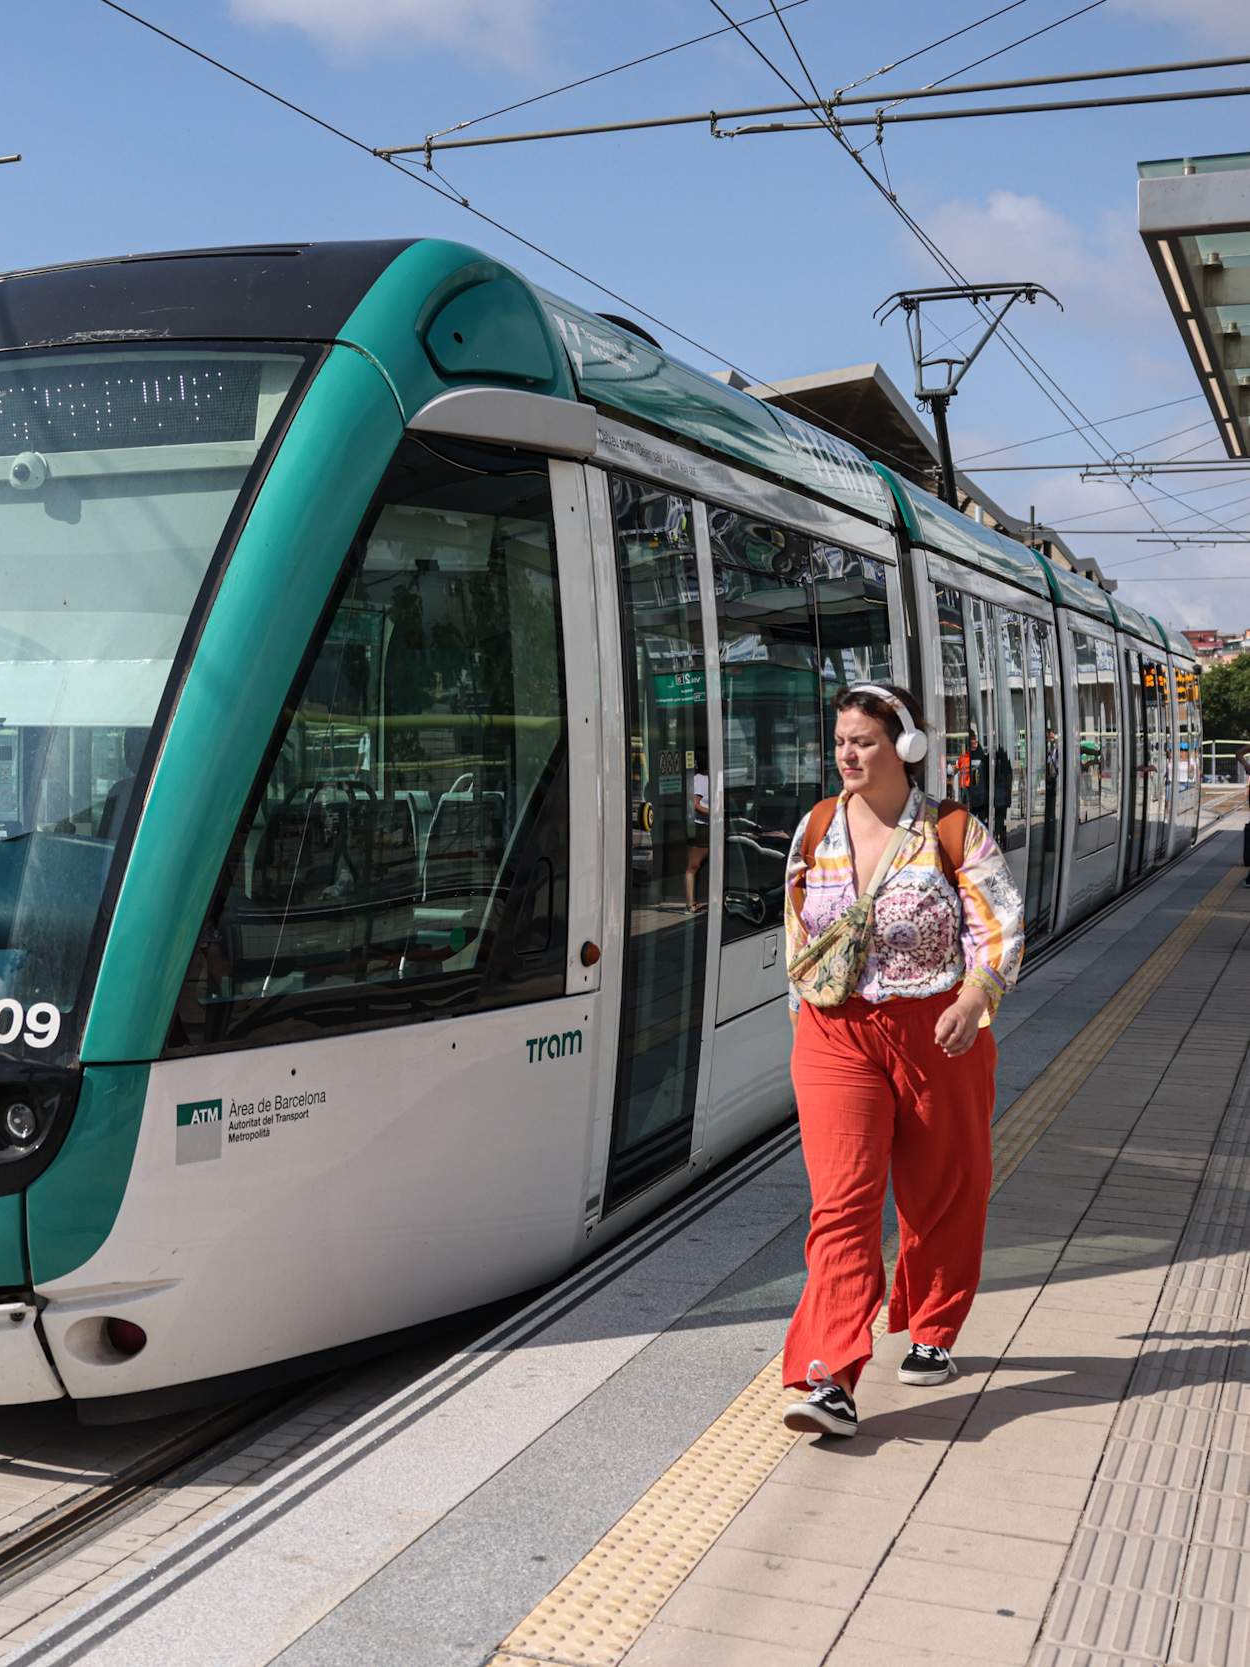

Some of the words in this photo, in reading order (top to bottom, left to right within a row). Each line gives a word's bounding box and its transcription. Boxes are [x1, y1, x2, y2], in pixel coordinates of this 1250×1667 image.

[229, 1099, 254, 1118] Àrea
[258, 1097, 272, 1114] de
[274, 1091, 326, 1110] Barcelona
[191, 1107, 218, 1125] ATM
[228, 1117, 261, 1132] Autoritat
[262, 1114, 274, 1125] del
[276, 1110, 309, 1124] Transport
[228, 1128, 270, 1144] Metropolità
